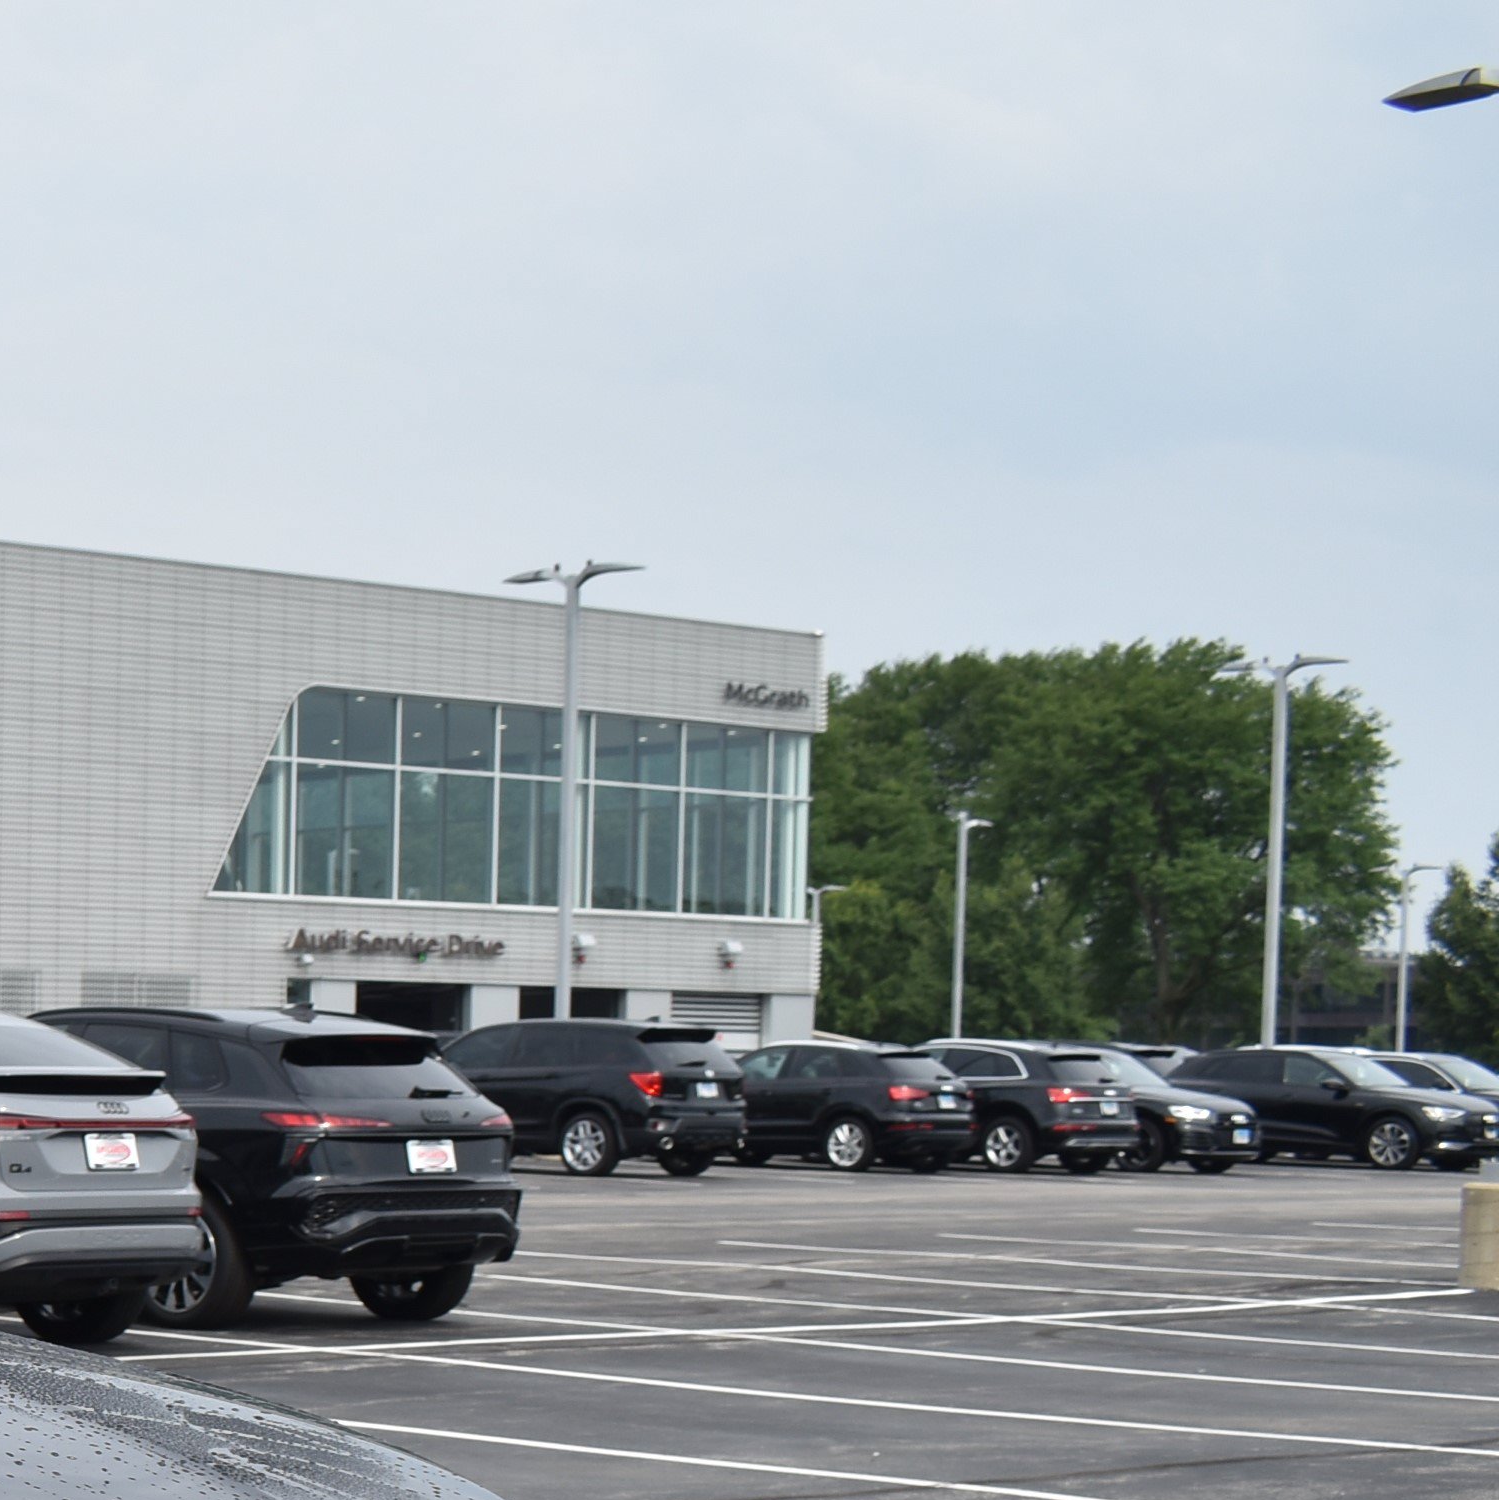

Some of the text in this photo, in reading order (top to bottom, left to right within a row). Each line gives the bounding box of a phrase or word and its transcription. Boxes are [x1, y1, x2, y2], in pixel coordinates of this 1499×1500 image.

[723, 682, 810, 710] McGrath
[289, 928, 506, 956] Audi Service Drive
